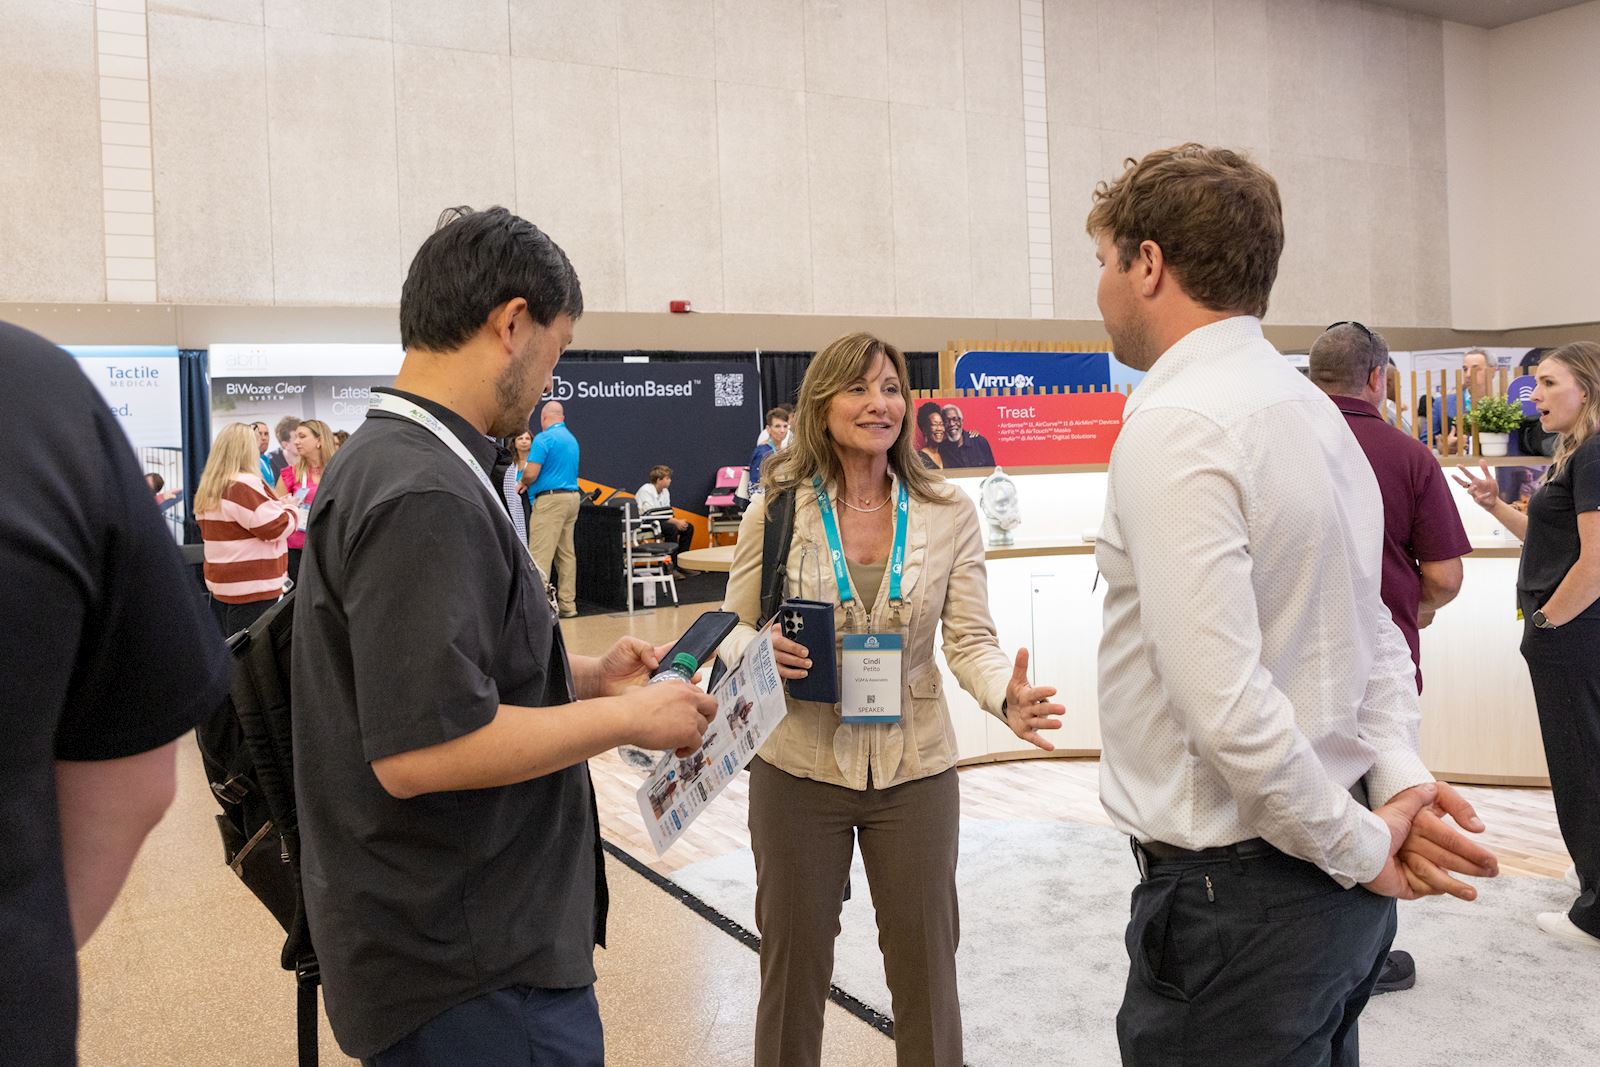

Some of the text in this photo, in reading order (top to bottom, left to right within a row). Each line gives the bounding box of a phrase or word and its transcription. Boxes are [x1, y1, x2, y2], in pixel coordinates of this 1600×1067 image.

[106, 366, 159, 379] Tactile
[275, 382, 307, 394] Clear
[332, 385, 372, 399] Lates
[997, 406, 1036, 419] Treat
